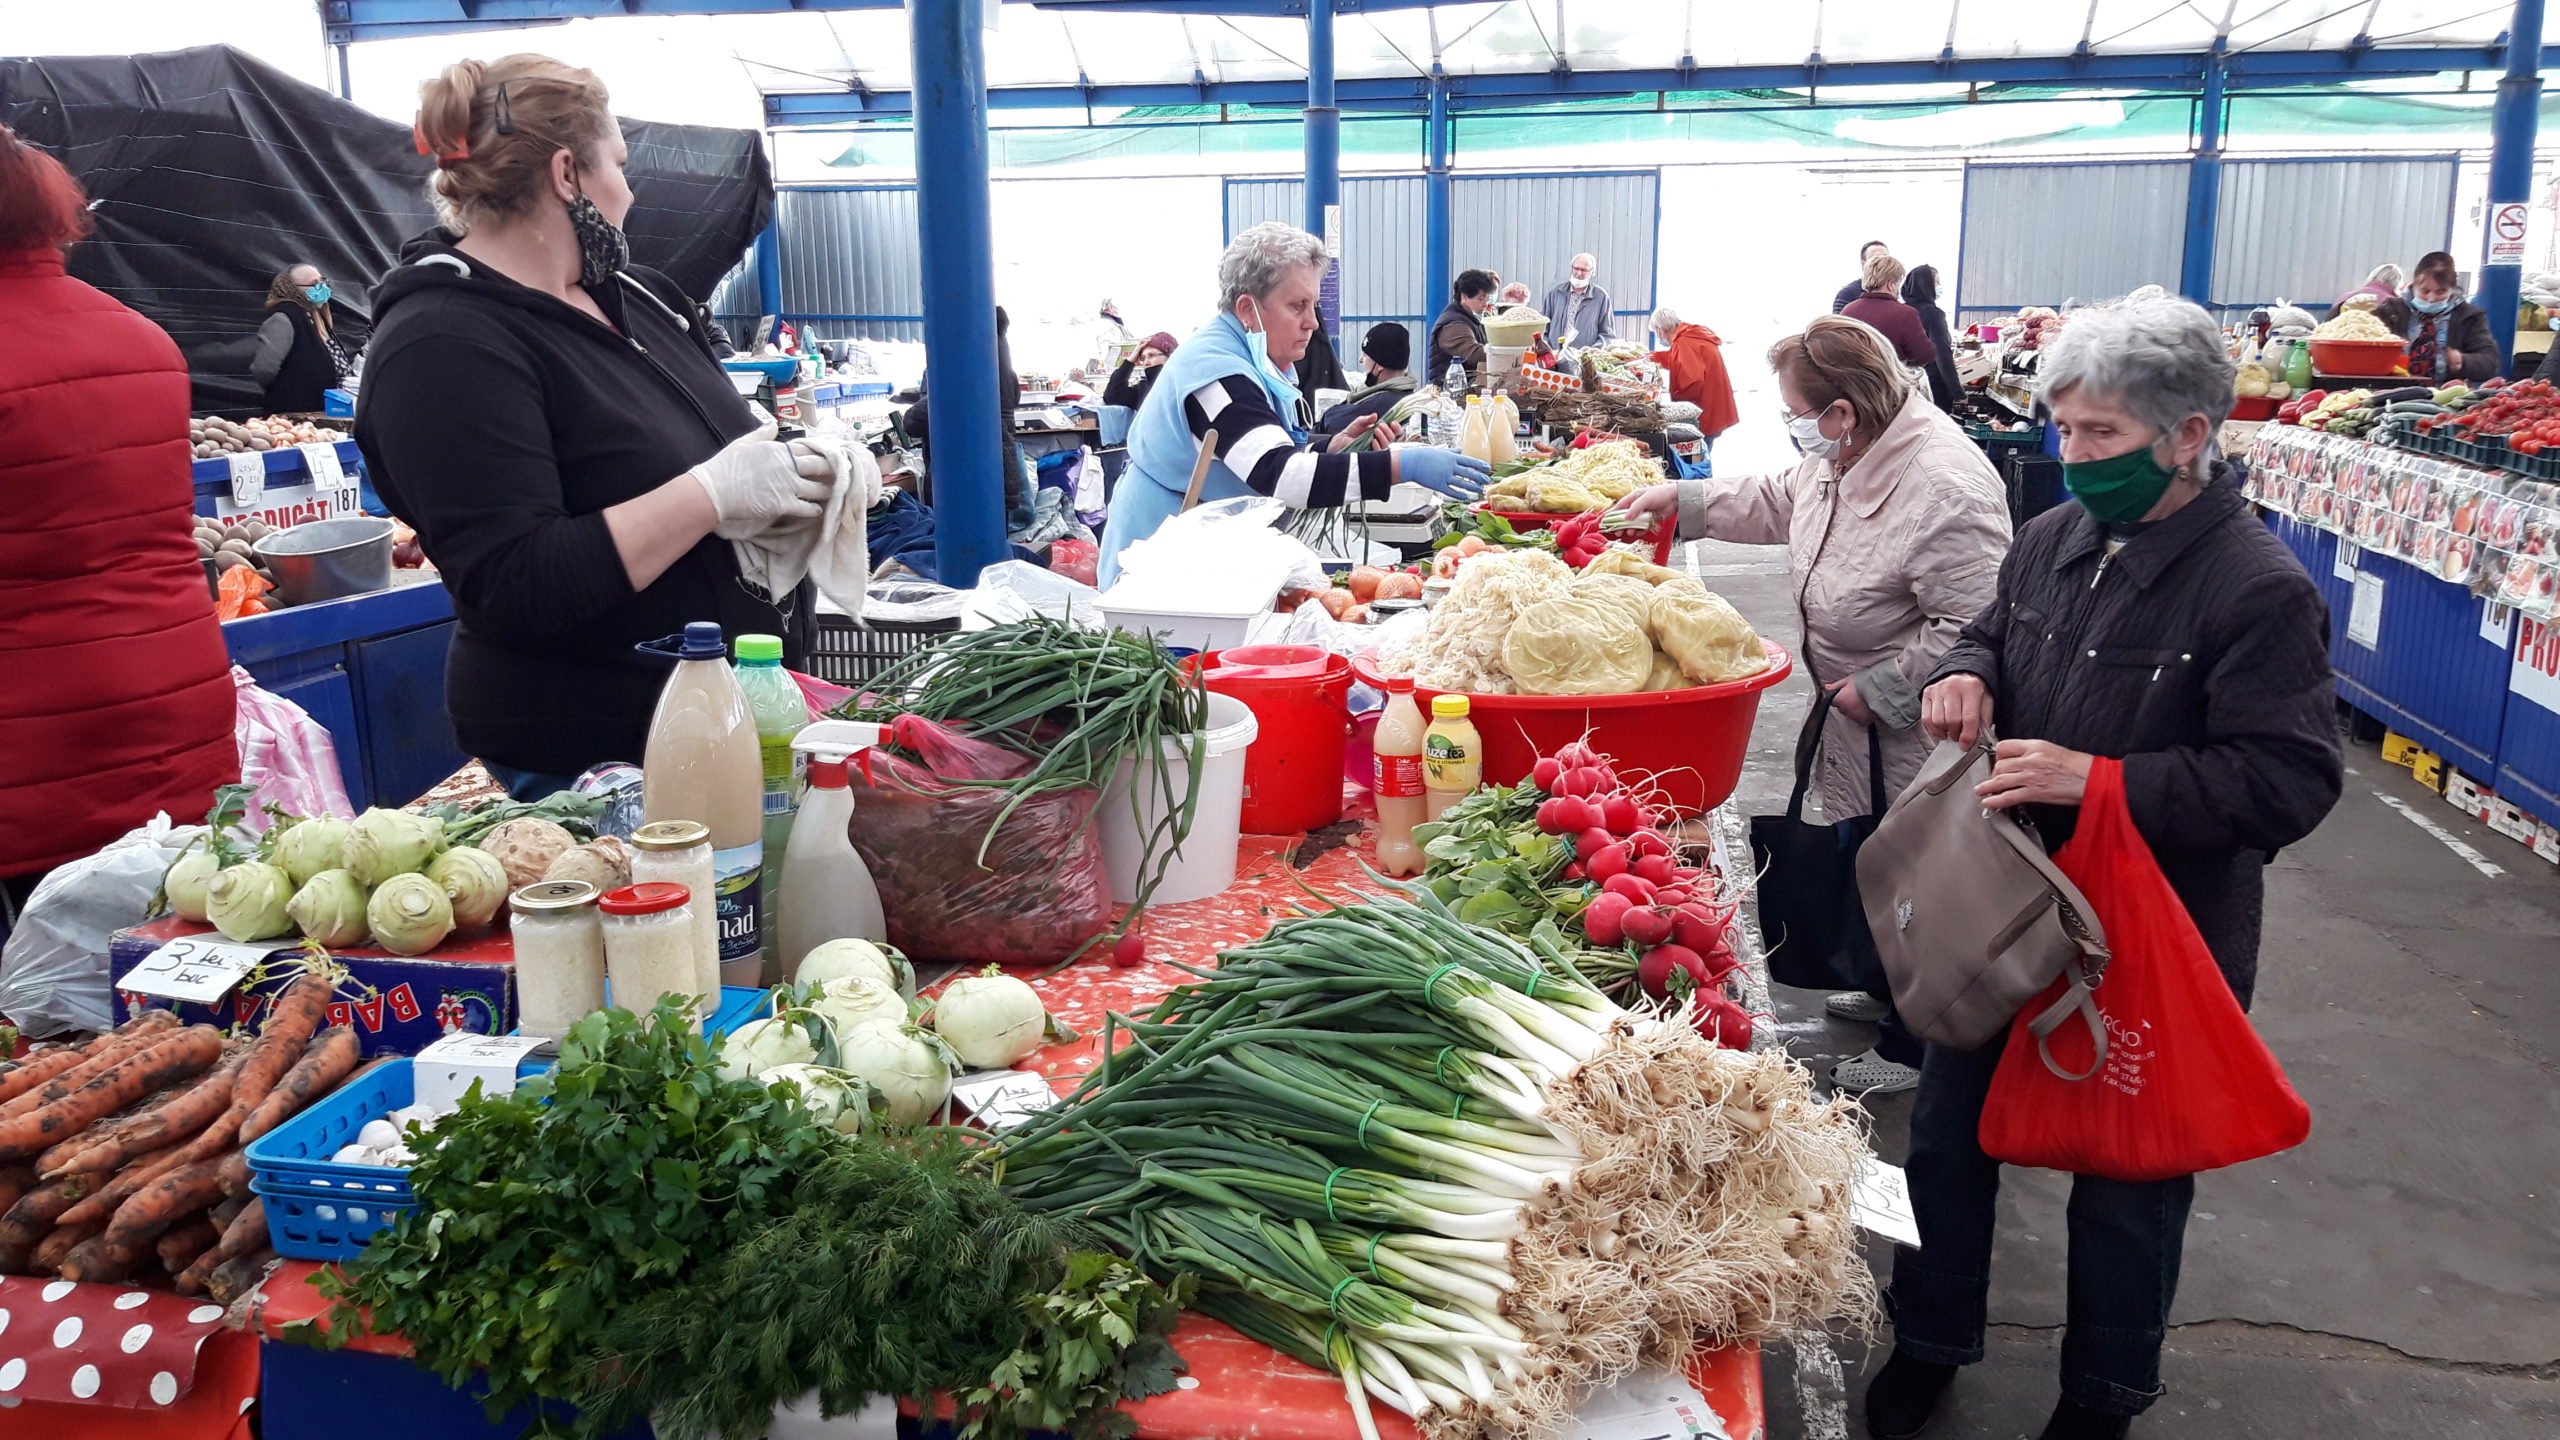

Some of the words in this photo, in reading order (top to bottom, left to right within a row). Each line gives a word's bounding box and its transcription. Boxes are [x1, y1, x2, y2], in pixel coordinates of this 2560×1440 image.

[235, 475, 248, 501] 2
[333, 487, 357, 513] 187
[2517, 616, 2560, 679] PRO
[716, 904, 754, 940] nad
[144, 942, 195, 972] 3
[173, 967, 210, 985] buc
